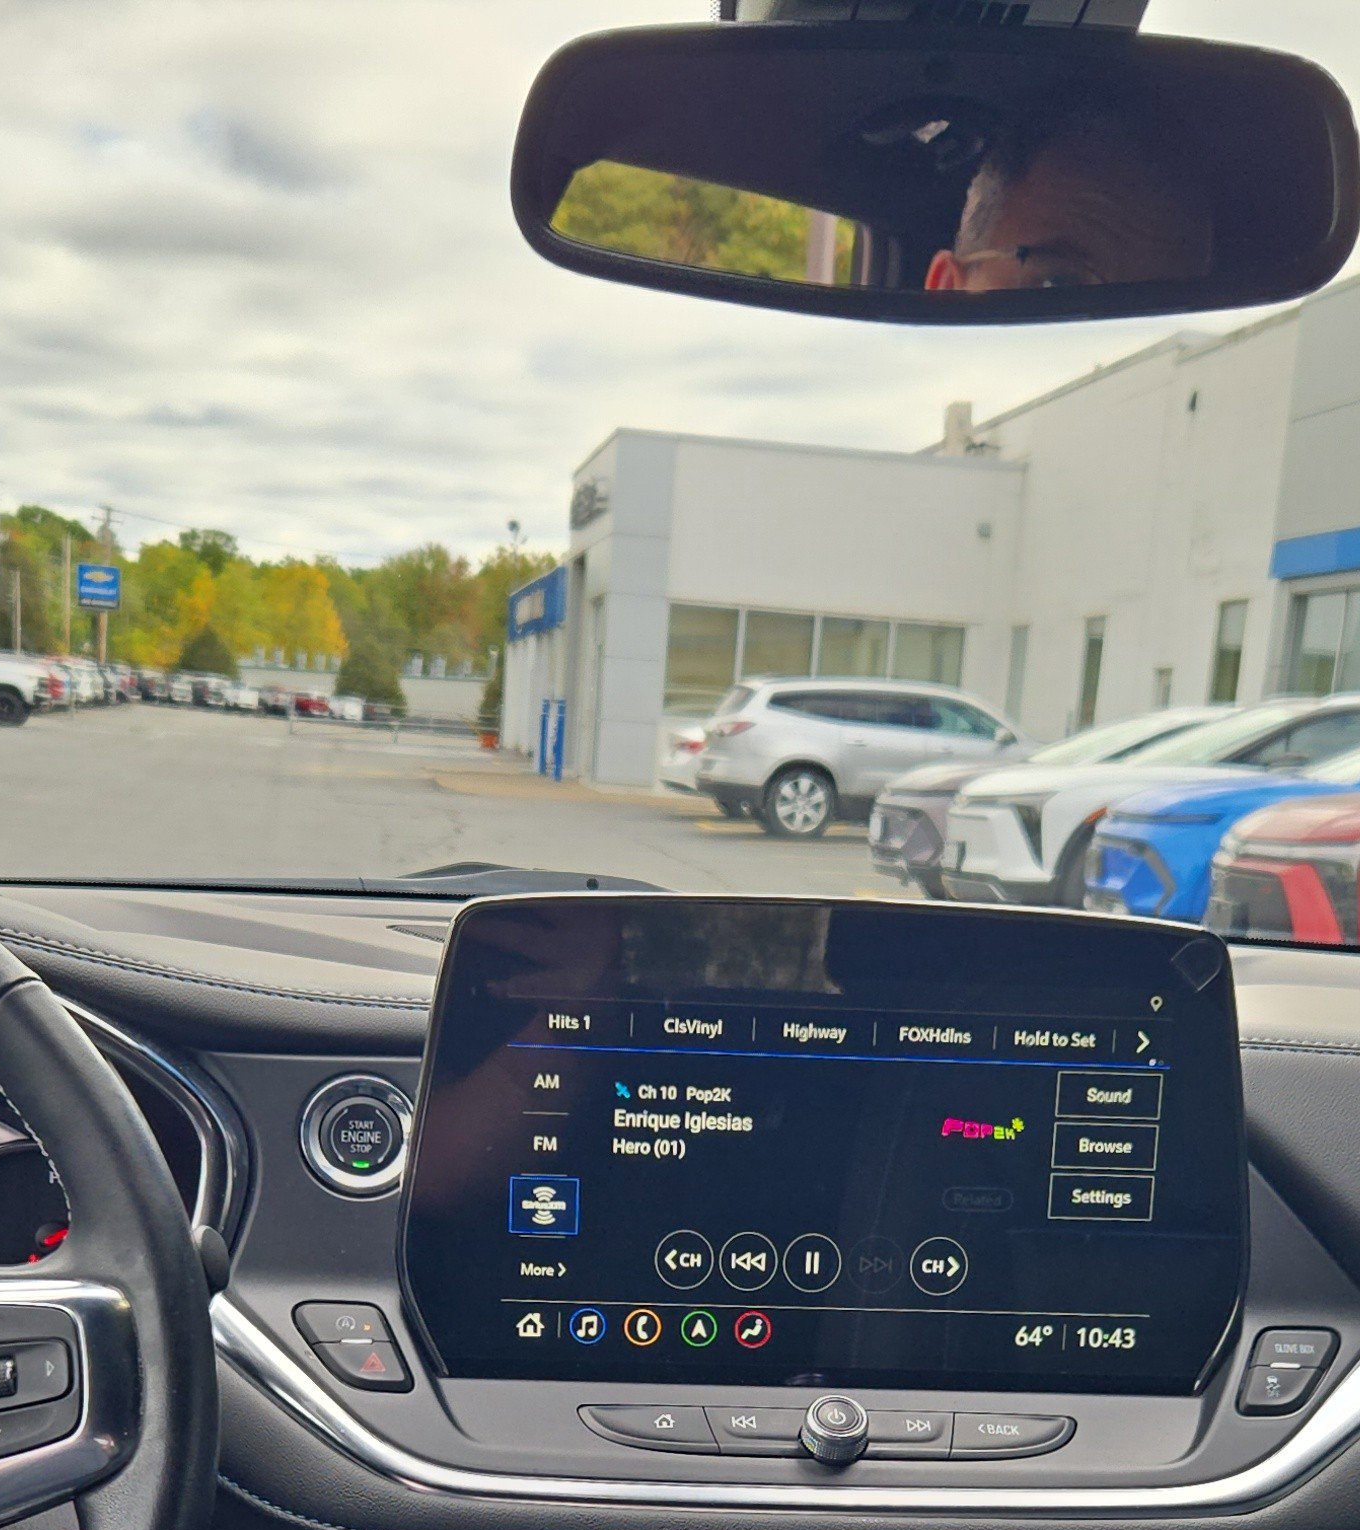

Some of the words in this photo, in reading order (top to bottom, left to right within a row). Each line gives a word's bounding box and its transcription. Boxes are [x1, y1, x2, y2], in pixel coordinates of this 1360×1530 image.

[548, 1013, 579, 1030] Hits
[583, 1014, 591, 1030] 1
[663, 1017, 723, 1039] ClsVinyl
[783, 1022, 847, 1044] Highway
[1014, 1030, 1050, 1047] Hold
[1052, 1033, 1069, 1047] to
[1071, 1032, 1096, 1048] Set
[534, 1074, 560, 1089] AM
[638, 1085, 657, 1100] Ch
[659, 1085, 677, 1101] 10
[686, 1086, 732, 1104] Pop2K
[1086, 1086, 1133, 1104] Sound
[348, 1120, 374, 1129] START
[613, 1108, 681, 1132] Enrique
[684, 1110, 753, 1134] Iglesias
[341, 1130, 381, 1144] ENGINE
[533, 1136, 558, 1152] FM
[350, 1144, 372, 1153] STOP
[612, 1137, 651, 1156] Hero
[653, 1138, 686, 1160] (01)
[1078, 1137, 1133, 1155] Browse
[1071, 1189, 1132, 1208] Settings
[679, 1253, 702, 1268] CH
[921, 1259, 945, 1274] CH
[520, 1262, 554, 1277] More
[1076, 1327, 1136, 1350] 10:43
[986, 1424, 1020, 1437] BACK
